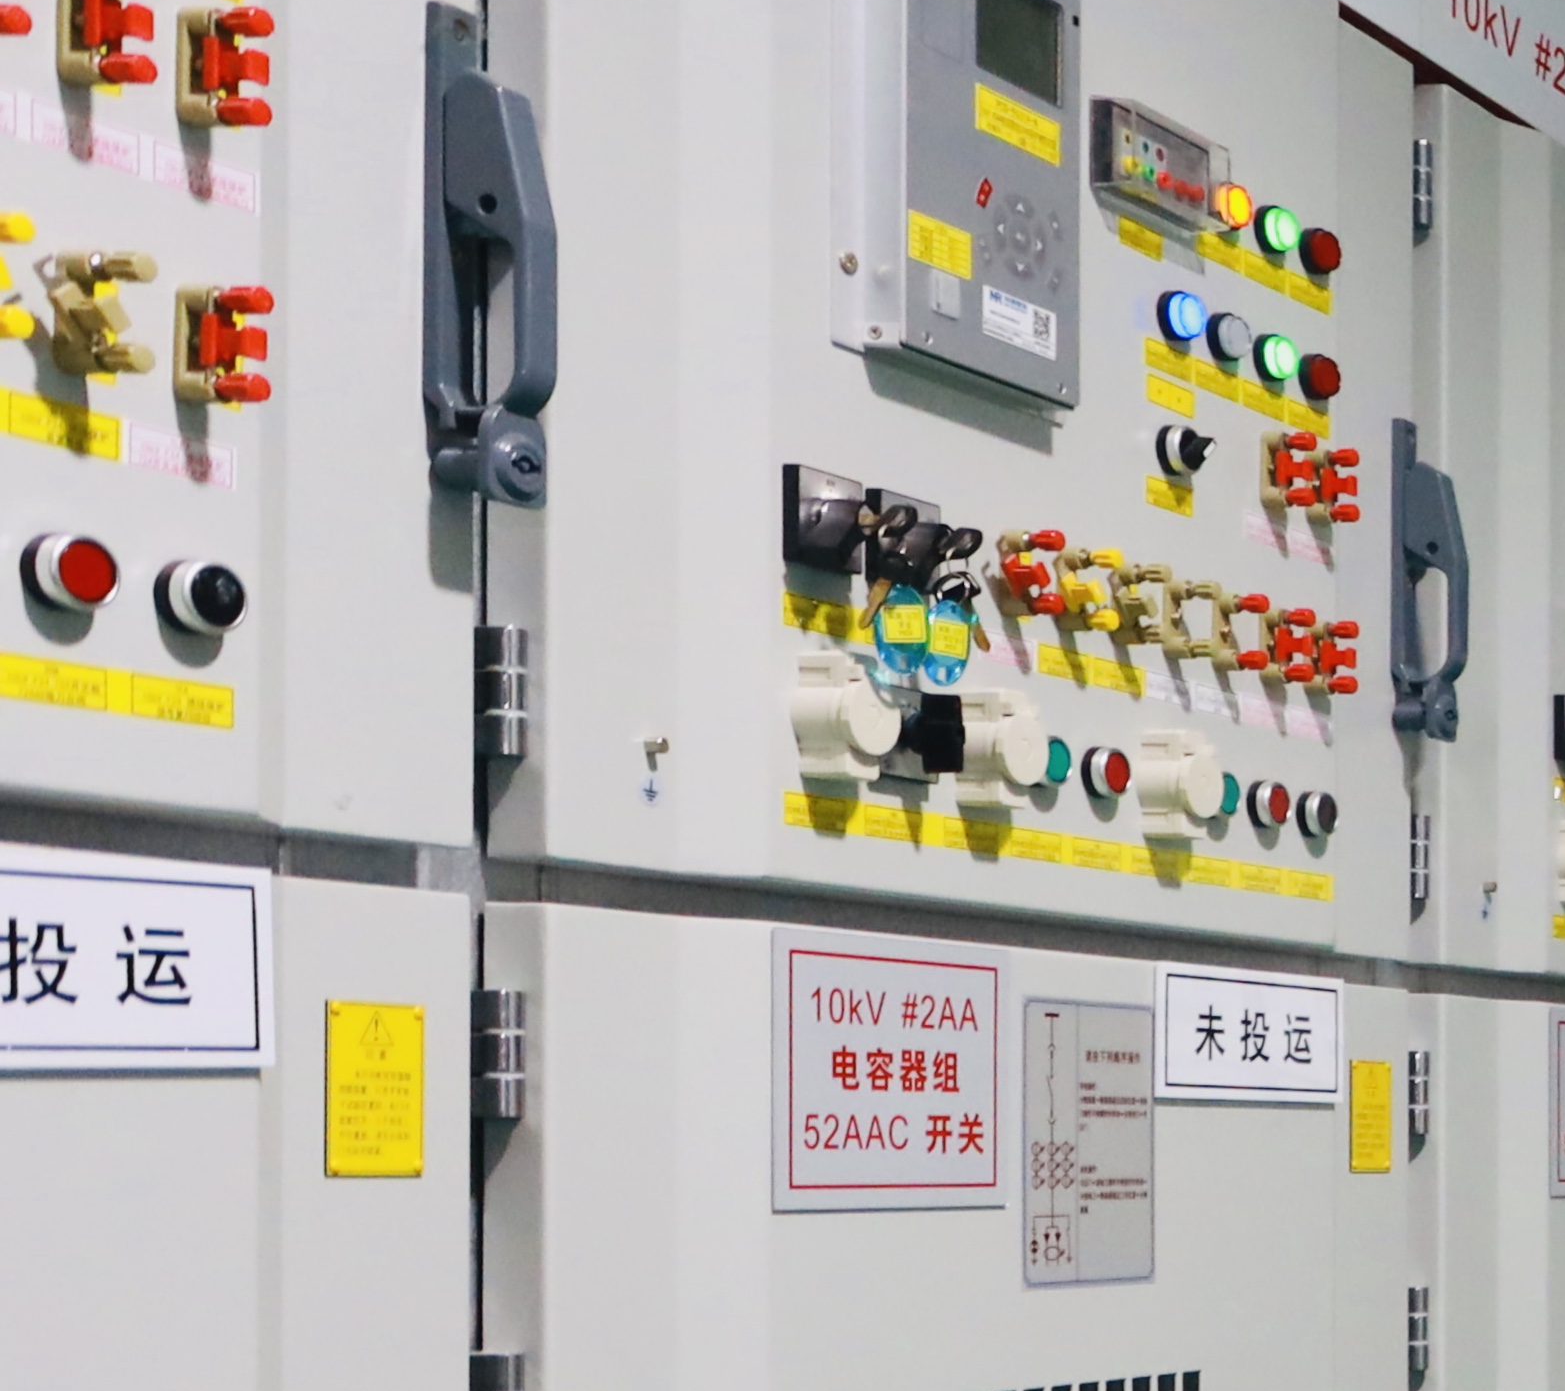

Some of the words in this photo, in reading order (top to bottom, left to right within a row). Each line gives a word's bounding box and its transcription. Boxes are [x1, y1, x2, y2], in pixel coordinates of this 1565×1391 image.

[811, 986, 887, 1027] 10kV
[902, 994, 978, 1033] #2AA
[1194, 1004, 1313, 1065] 未投运
[831, 1046, 961, 1094] 电容器组
[804, 1113, 910, 1152] 52AAC
[925, 1114, 985, 1156] 开关
